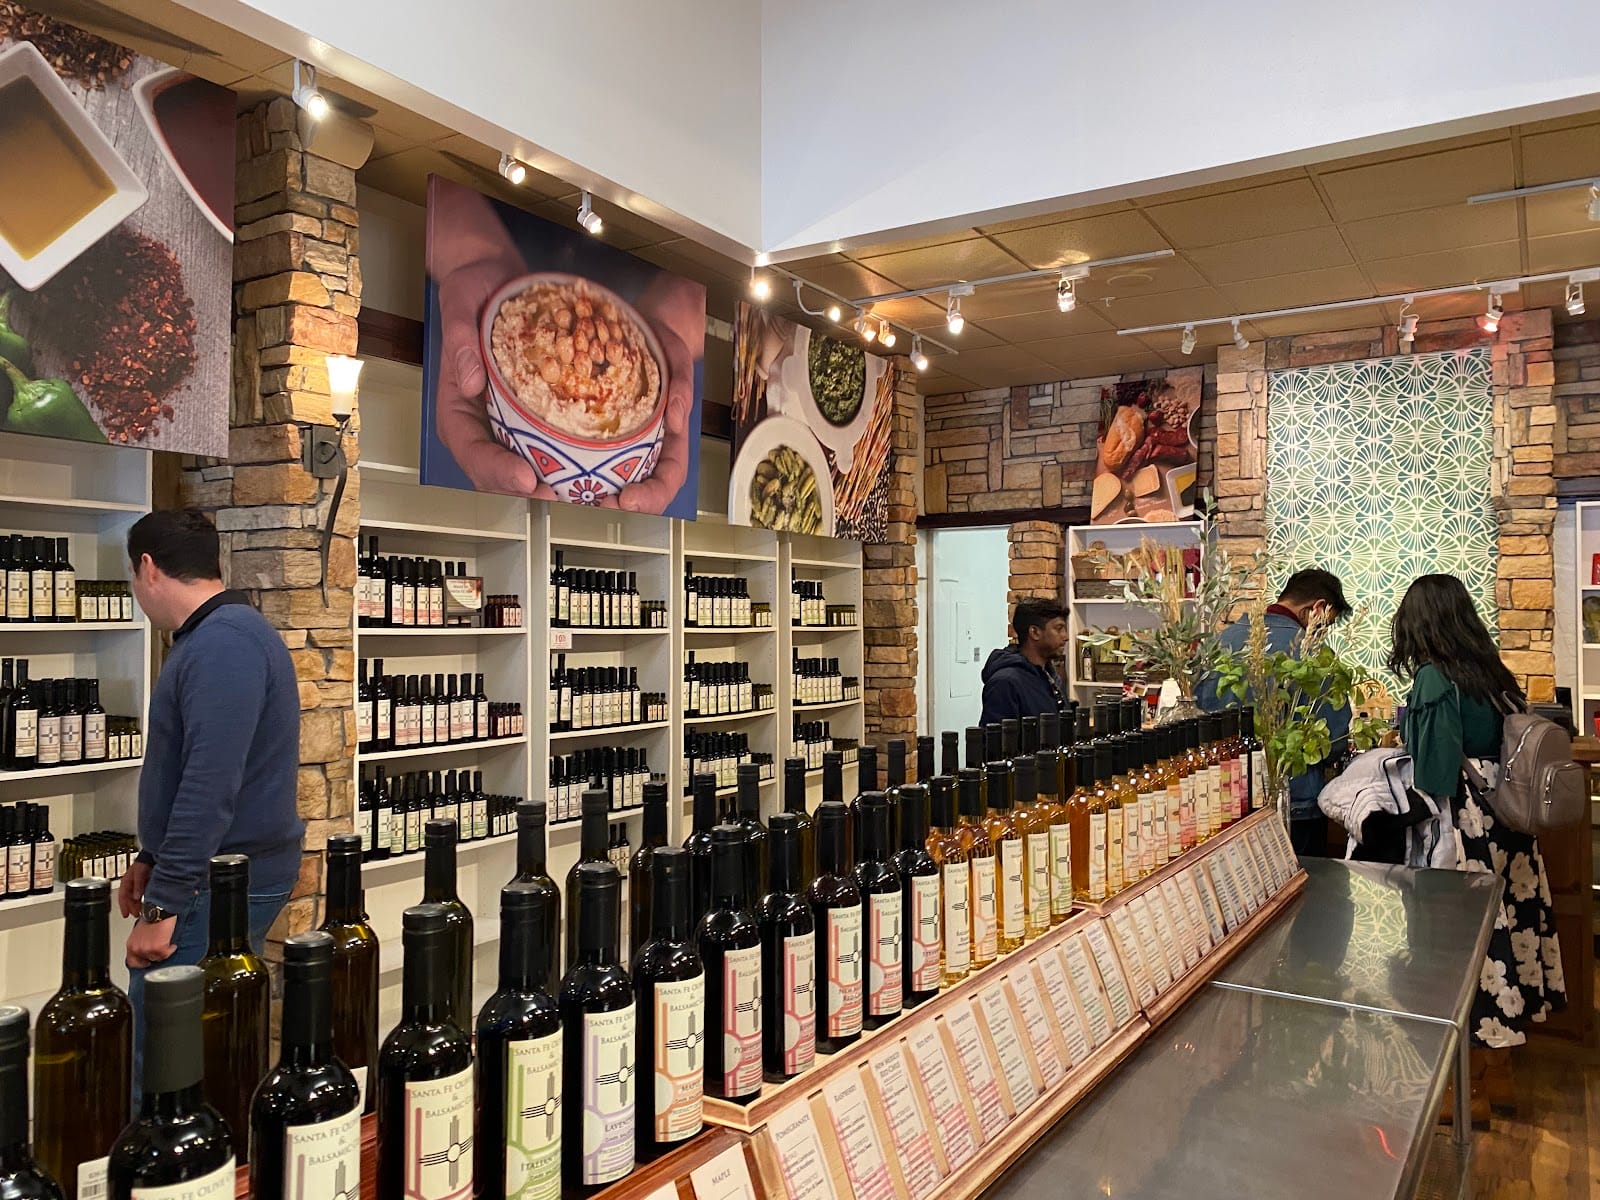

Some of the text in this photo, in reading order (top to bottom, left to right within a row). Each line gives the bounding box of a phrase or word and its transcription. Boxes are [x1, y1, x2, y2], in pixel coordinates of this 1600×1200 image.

[660, 988, 682, 996] SANTA
[590, 1018, 614, 1028] SANTA
[513, 1046, 540, 1057] SANTA
[412, 1088, 442, 1099] SANTA
[443, 1084, 453, 1094] FE
[293, 1132, 327, 1144] SANTA
[329, 1126, 341, 1138] FE
[774, 1113, 811, 1142] POMEGRANATE
[711, 1168, 732, 1184] MAPLE
